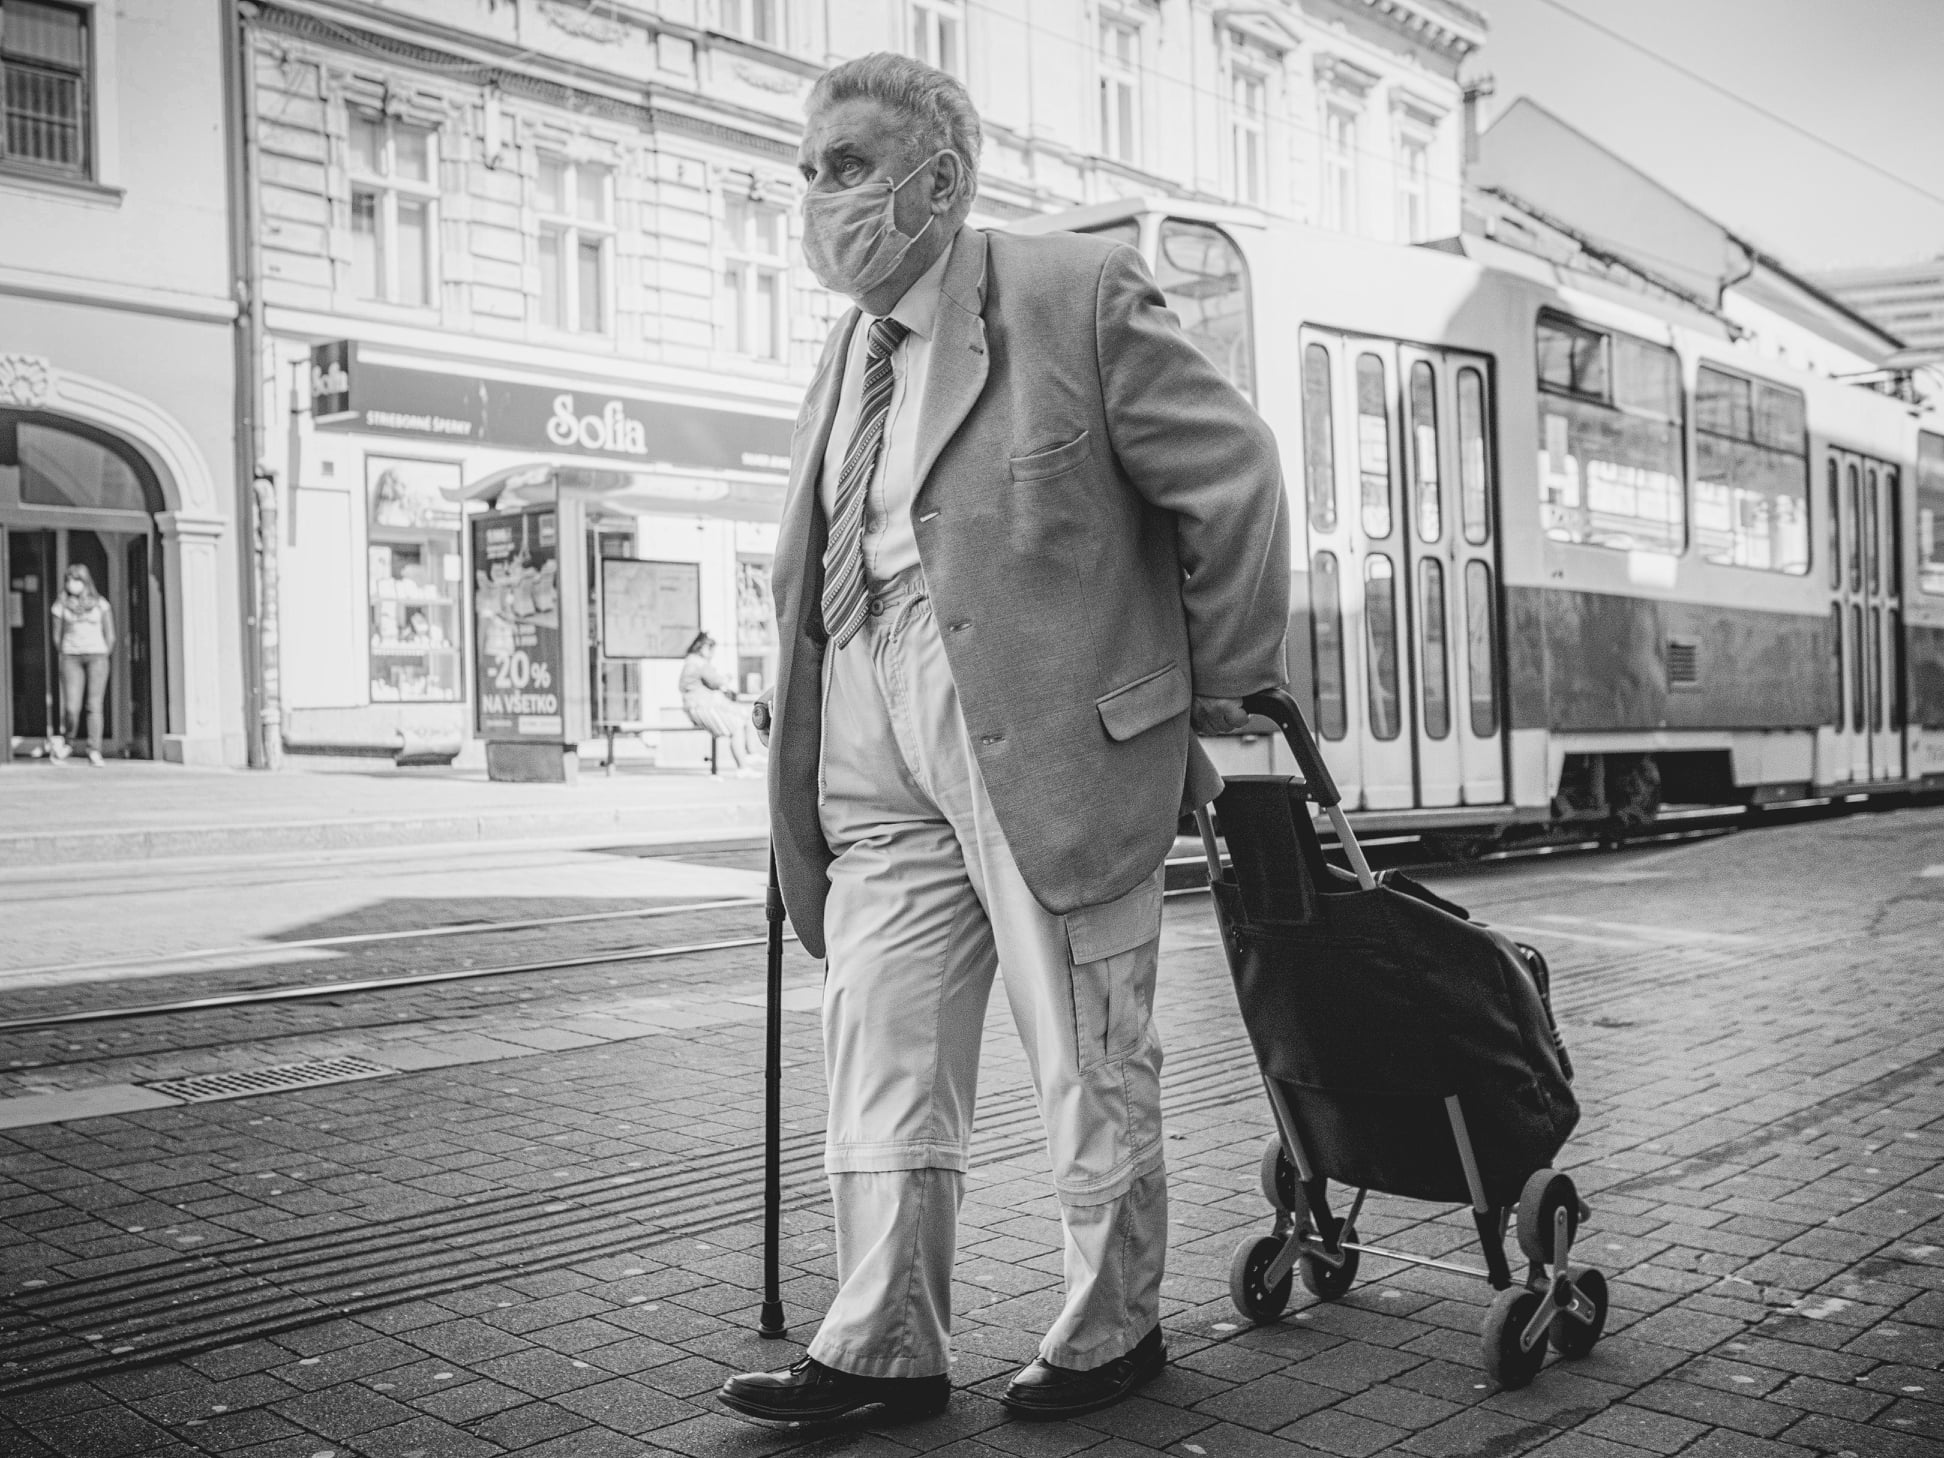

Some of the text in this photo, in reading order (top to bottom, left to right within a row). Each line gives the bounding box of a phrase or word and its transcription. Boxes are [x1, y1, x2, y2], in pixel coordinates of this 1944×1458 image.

[432, 415, 472, 435] ŠPERKY
[546, 394, 648, 454] Sofia
[482, 688, 557, 714] NA VŠETKO
